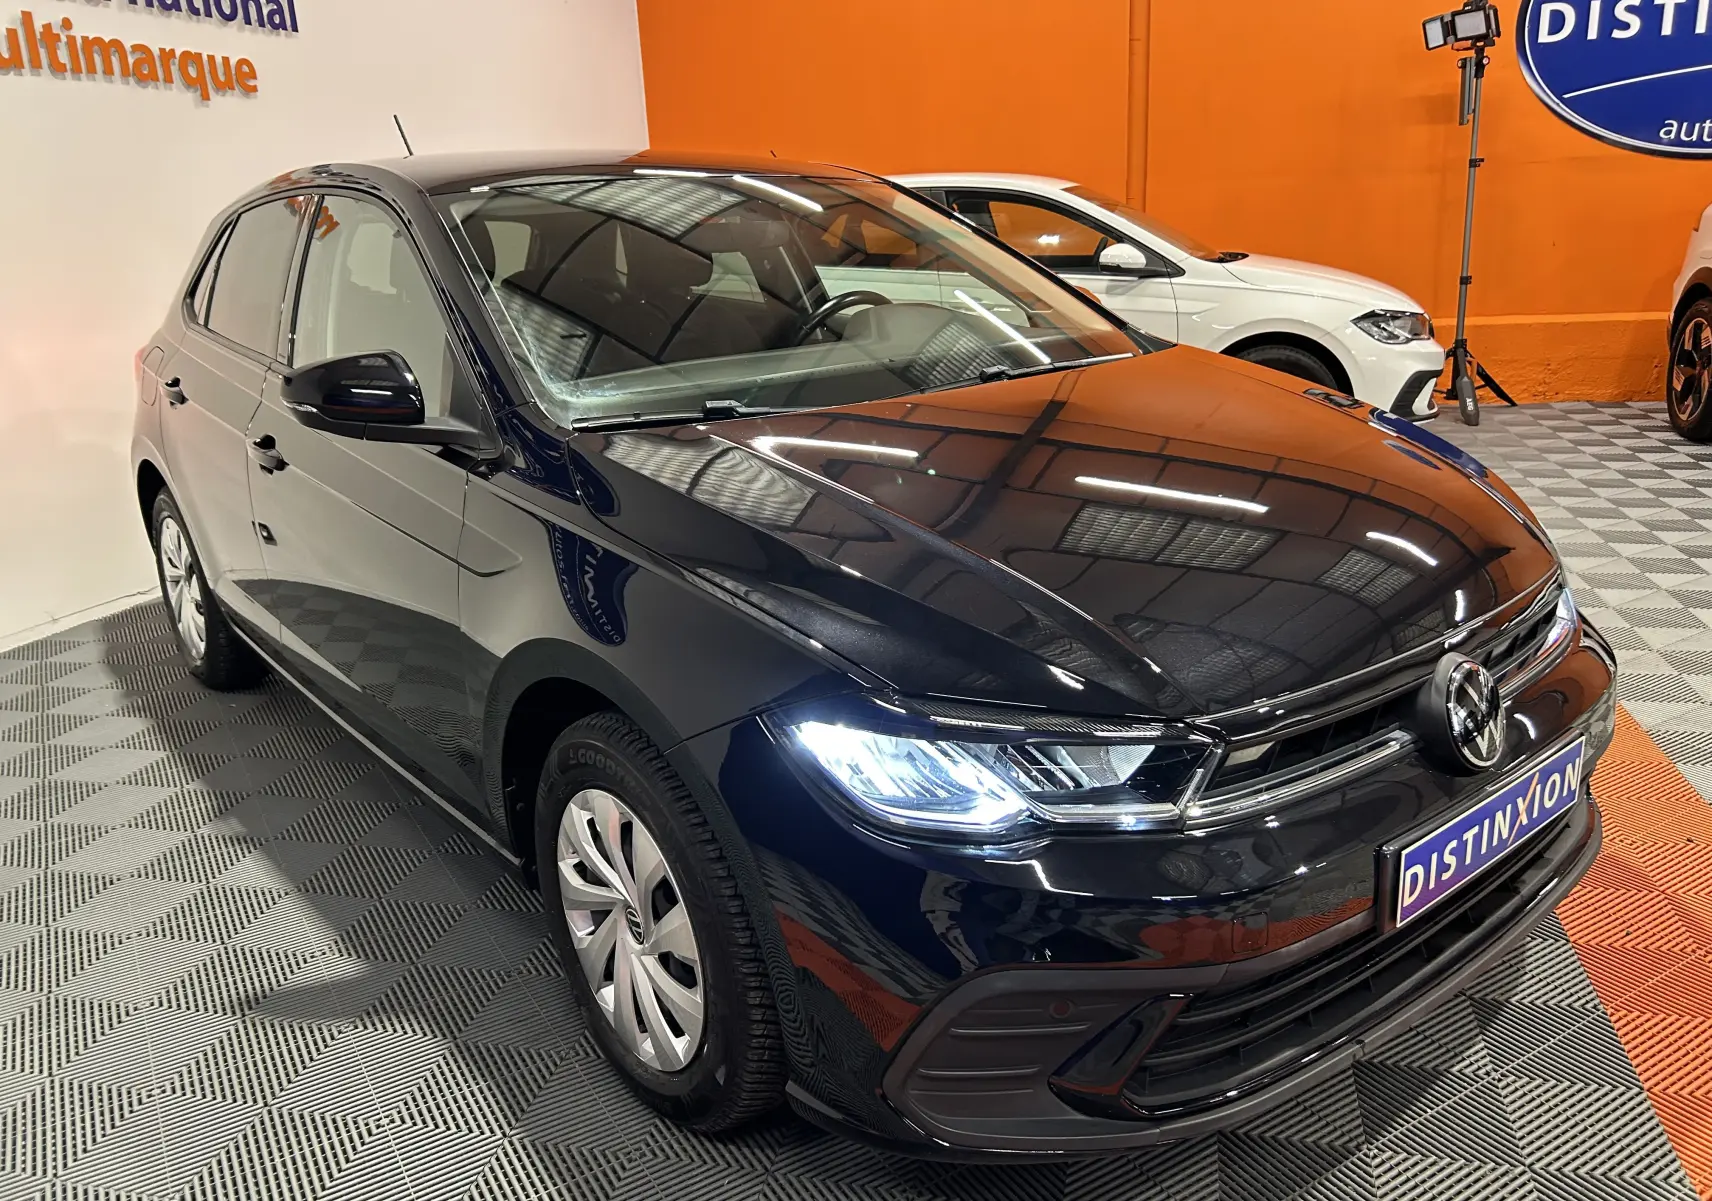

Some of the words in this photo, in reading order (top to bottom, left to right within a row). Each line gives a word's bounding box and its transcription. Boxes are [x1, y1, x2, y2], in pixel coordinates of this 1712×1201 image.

[126, 0, 299, 33] onal
[1537, 0, 1710, 43] DISTI
[1402, 757, 1581, 908] DISTINXION
